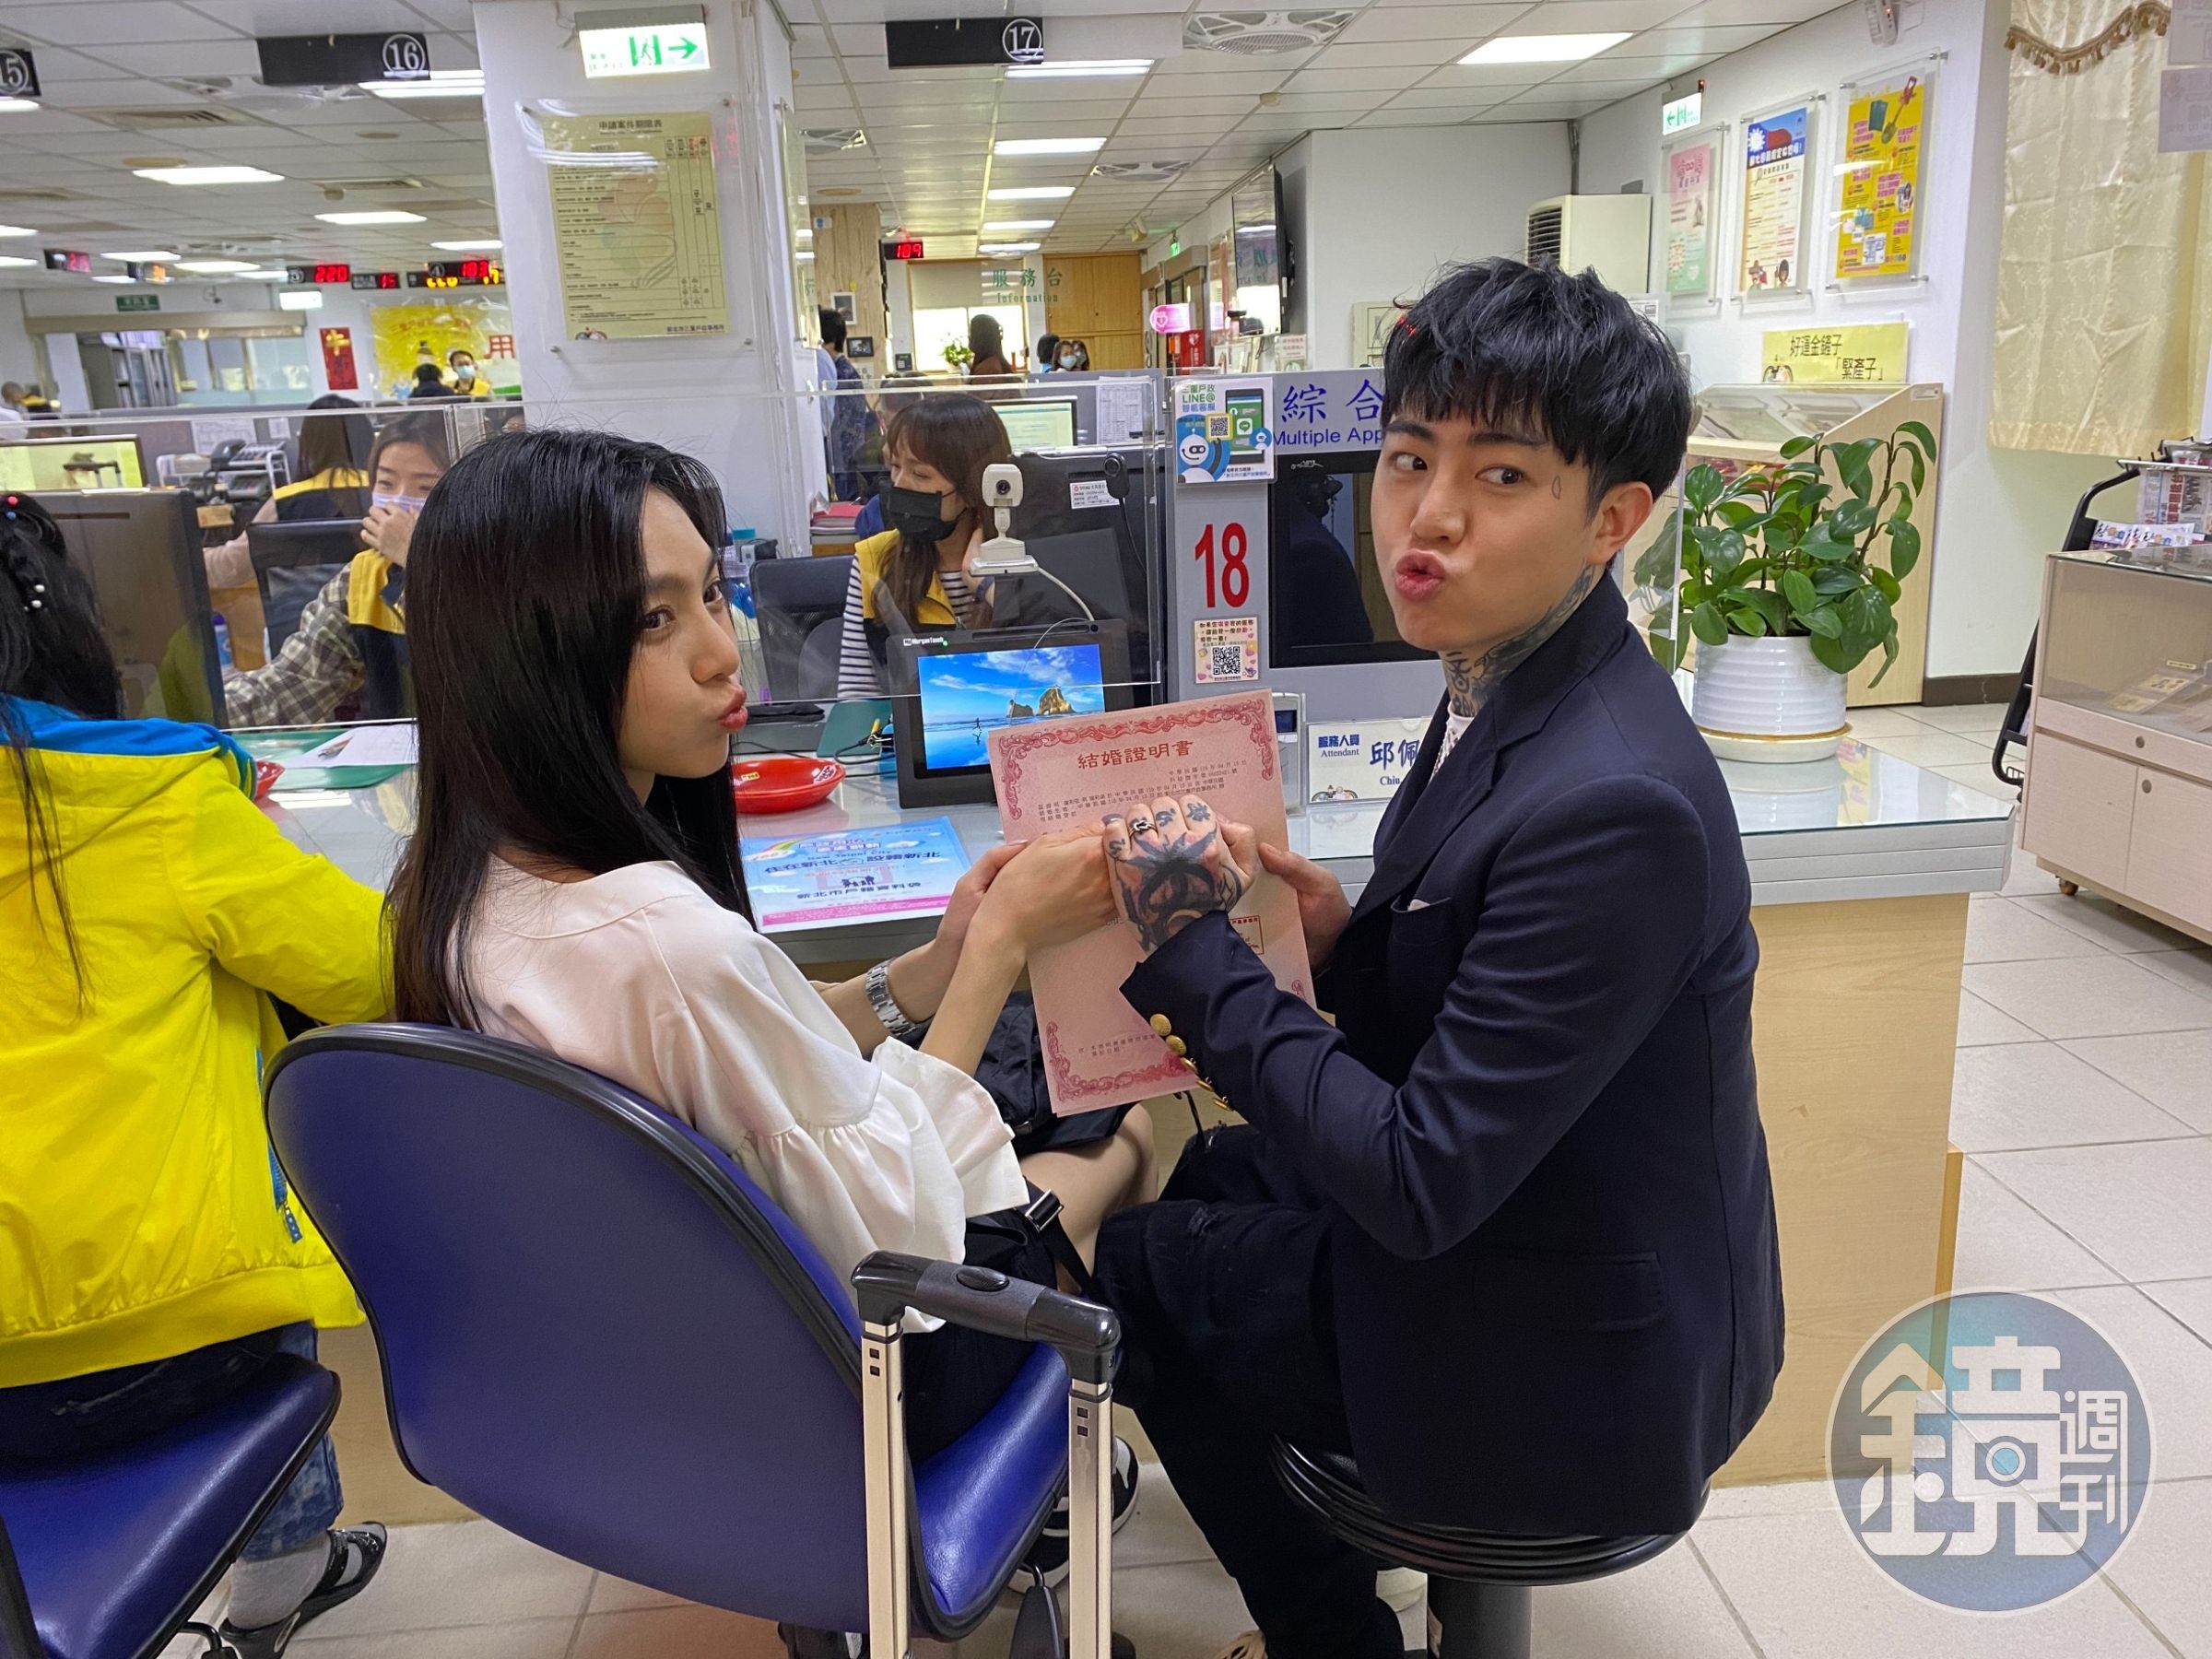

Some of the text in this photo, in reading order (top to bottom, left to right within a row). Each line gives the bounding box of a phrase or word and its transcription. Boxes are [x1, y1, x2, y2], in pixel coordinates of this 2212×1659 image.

[1008, 26, 1035, 53] 17
[388, 43, 420, 71] 16
[896, 243, 923, 259] 109
[993, 268, 1062, 288] 服務台
[997, 293, 1058, 303] Information
[1182, 394, 1215, 403] LINE@
[1281, 379, 1384, 423] 綜合
[1274, 429, 1341, 447] Multiple
[1194, 523, 1250, 608] 18
[1318, 734, 1359, 748] 服務人員
[1077, 740, 1194, 770] 結婚證明書
[1321, 748, 1359, 758] Attendant
[765, 859, 838, 873] 住在新北
